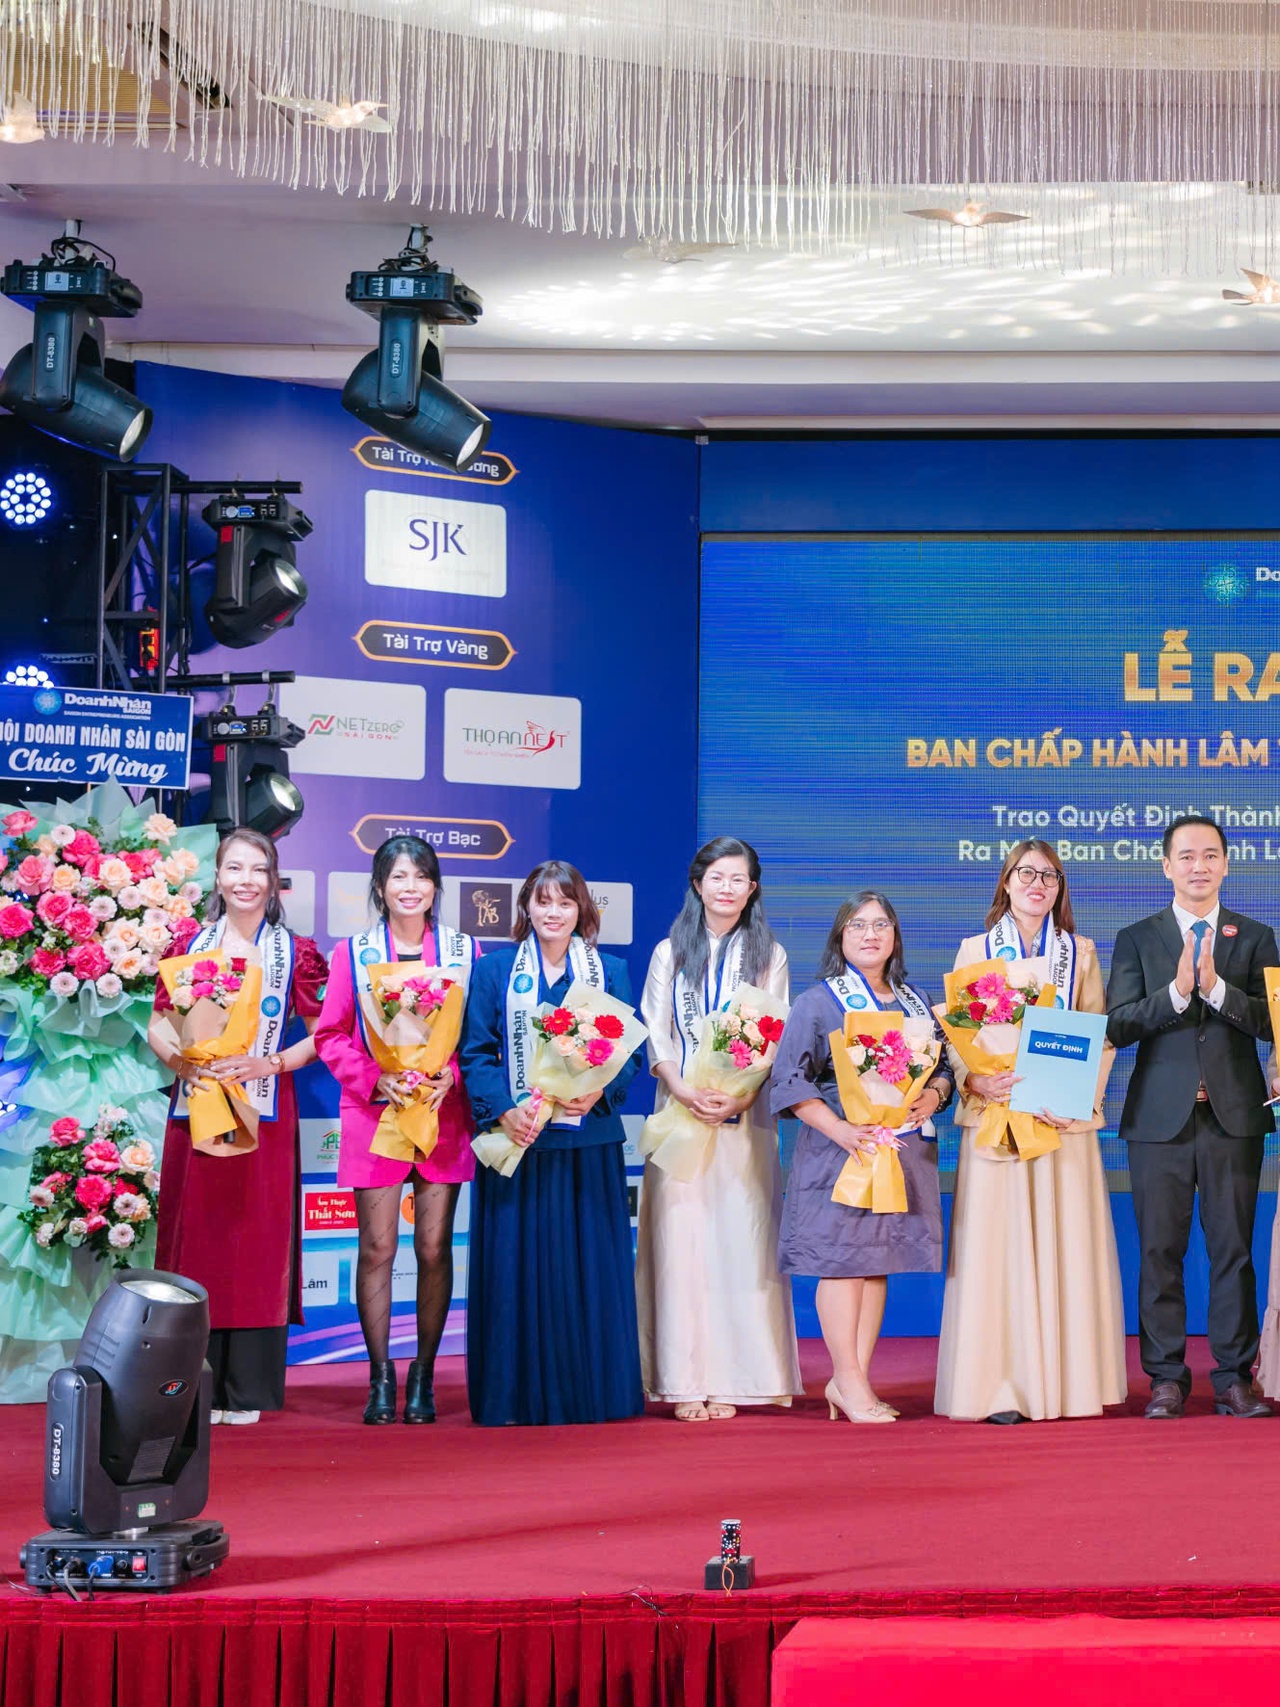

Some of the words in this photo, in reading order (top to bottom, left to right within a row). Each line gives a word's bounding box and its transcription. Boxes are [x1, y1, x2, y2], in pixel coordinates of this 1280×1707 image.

[46, 337, 56, 369] DT-8380
[391, 342, 402, 375] DT-8380
[372, 446, 394, 461] Tài
[409, 518, 467, 562] SJK
[383, 633, 409, 649] Tài
[413, 636, 442, 655] Trợ
[446, 638, 489, 660] Vàng
[1123, 629, 1193, 701] LỄ
[64, 692, 152, 710] DoanhNhân
[0, 718, 20, 747] ỘI
[25, 722, 75, 746] DOANH
[80, 724, 121, 748] NHÂN
[126, 726, 150, 750] SÀI
[155, 728, 186, 752] GÒN
[907, 738, 976, 767] BAN
[986, 727, 1082, 767] CHẤP
[1092, 730, 1188, 767] HÀNH
[1199, 730, 1269, 766] LÂM
[8, 748, 77, 773] Chúc
[86, 752, 168, 784] Mừng
[992, 805, 1050, 827] Trao
[1058, 802, 1136, 832] Quyết
[448, 831, 481, 848] Bạc
[958, 840, 991, 861] Ra
[1058, 839, 1106, 861] Ban
[1113, 838, 1164, 861] Chấ
[1035, 1040, 1061, 1051] QUYẾT
[1062, 1045, 1083, 1054] ĐỊNH
[51, 1428, 63, 1476] DT-8380
